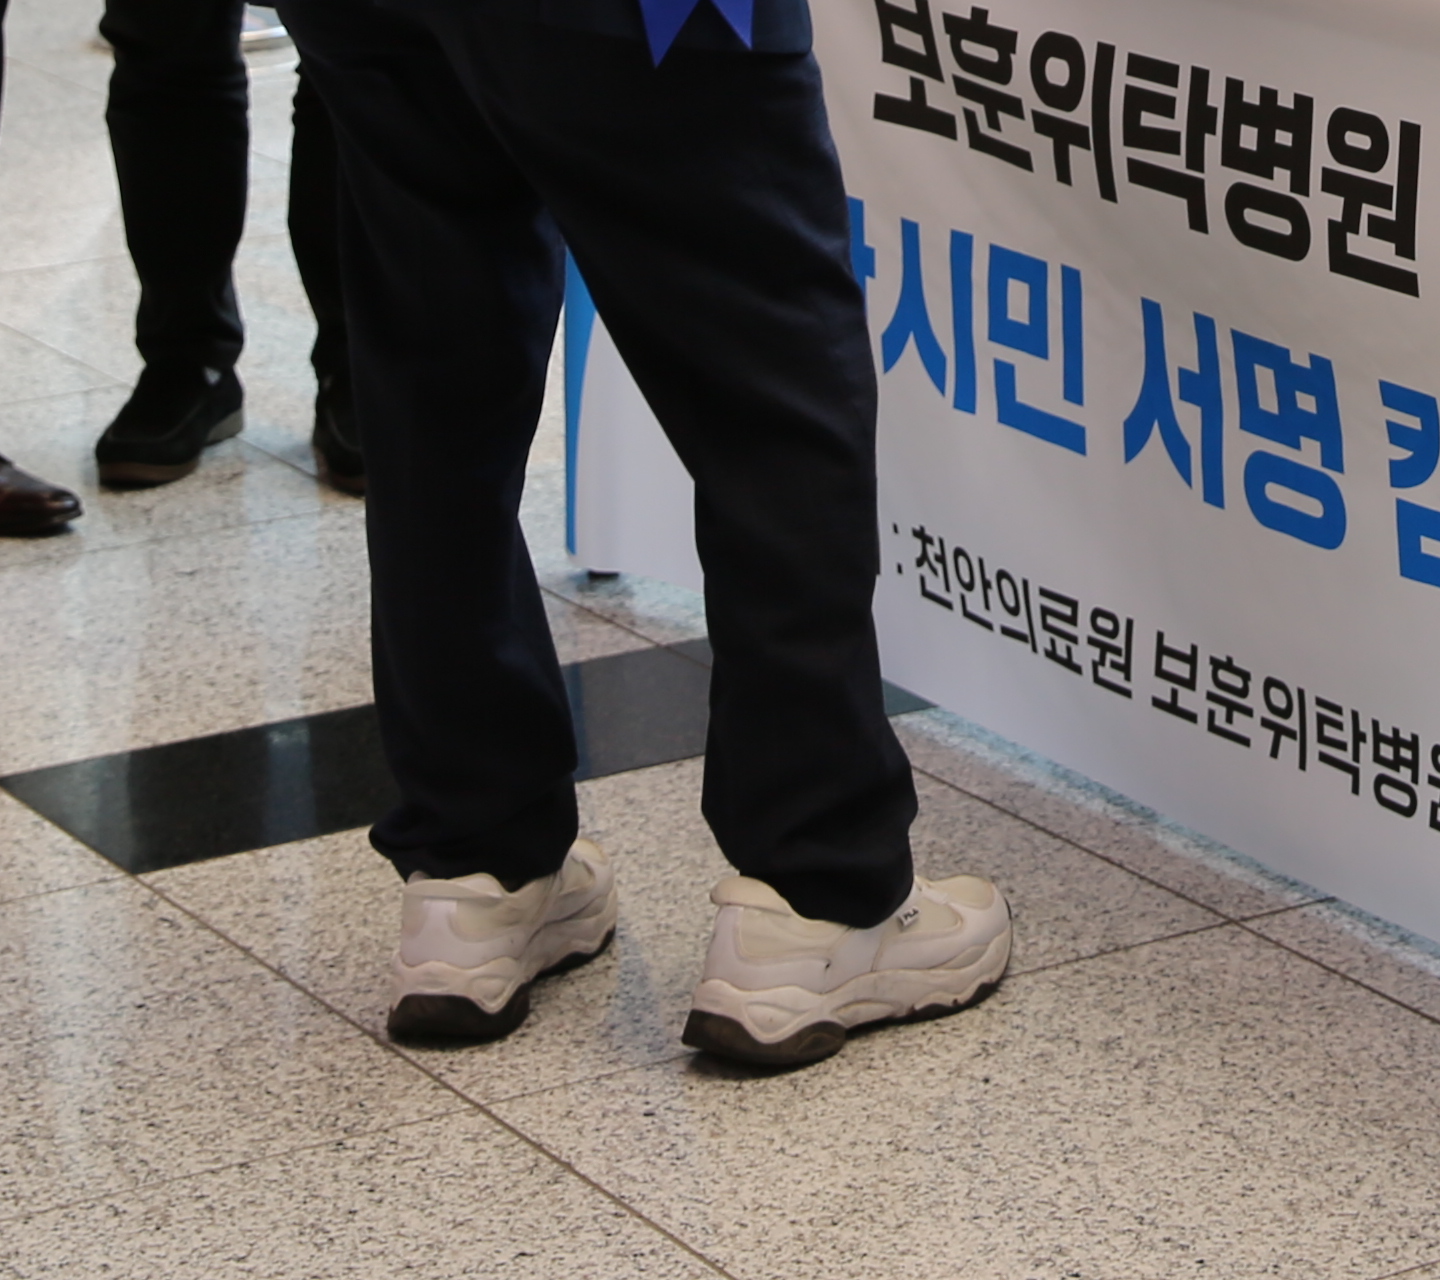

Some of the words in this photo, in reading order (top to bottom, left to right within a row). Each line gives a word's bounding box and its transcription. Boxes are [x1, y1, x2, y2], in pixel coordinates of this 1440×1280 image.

[845, 195, 1087, 458] 시민
[1123, 296, 1347, 550] 서명
[912, 524, 1134, 700] 천안의료원
